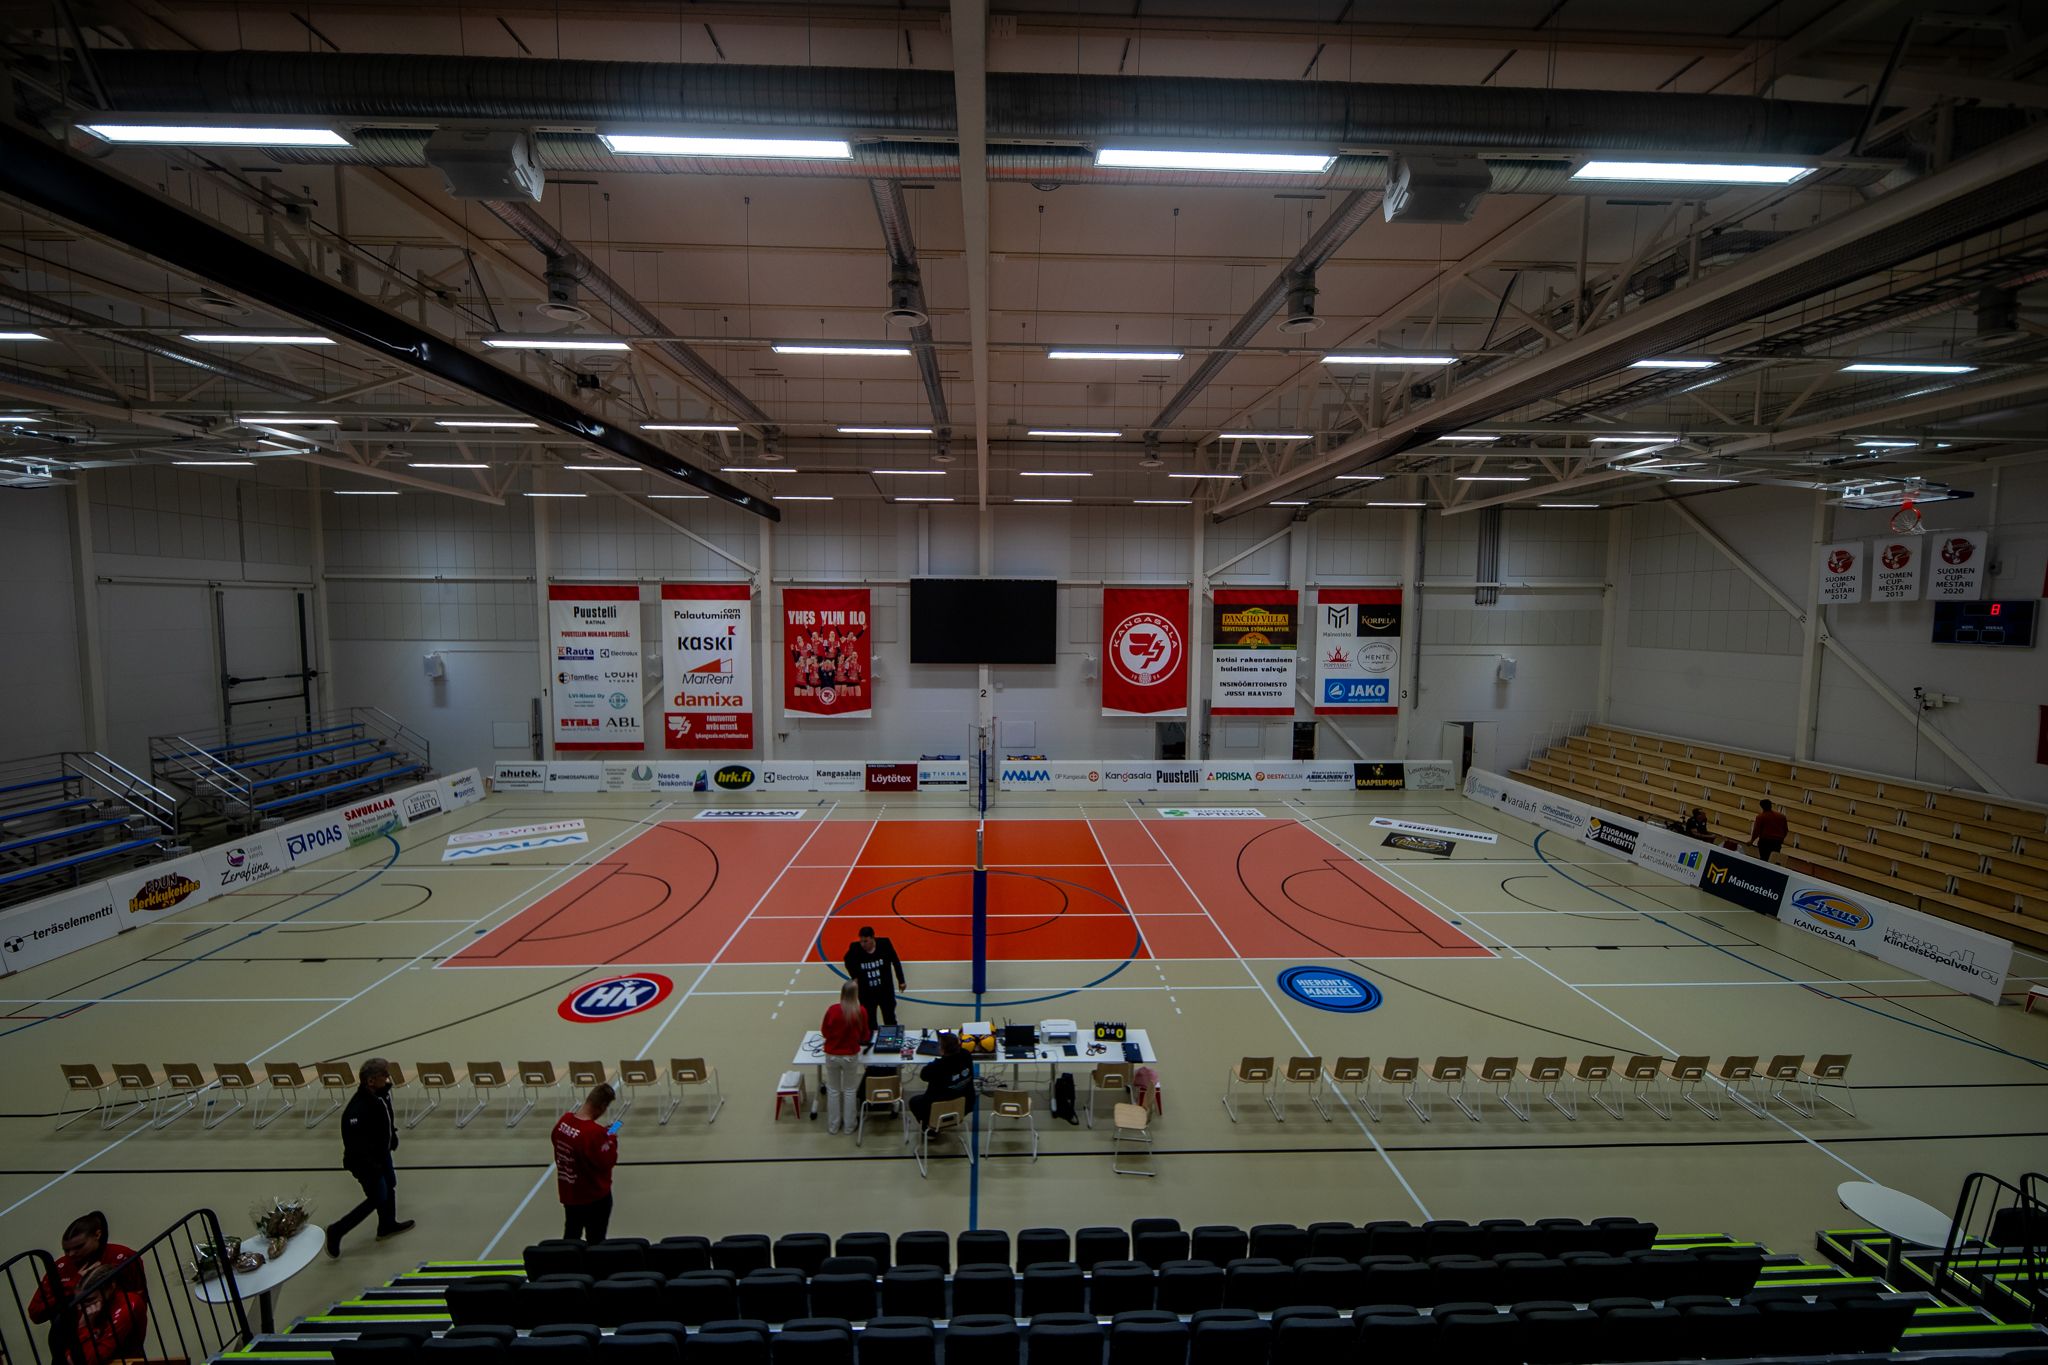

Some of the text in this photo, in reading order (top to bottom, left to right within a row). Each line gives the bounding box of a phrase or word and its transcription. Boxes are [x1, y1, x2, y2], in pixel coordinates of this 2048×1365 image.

[1879, 572, 1913, 580] SUOMEN
[1937, 567, 1975, 575] SUOMEN
[1878, 584, 1912, 592] MESTARI
[573, 605, 617, 618] Puustelli
[674, 610, 741, 620] Palautuminen
[1991, 603, 2001, 616] 8
[849, 611, 866, 625] ILO
[1223, 615, 1287, 623] PANCHO VILLA
[1113, 616, 1179, 649] KANGASALA
[566, 647, 594, 656] Rauta
[605, 671, 639, 679] LOUHI
[682, 673, 734, 685] MarRent
[981, 689, 987, 697] 2
[1347, 685, 1386, 697] JAKO
[1401, 690, 1408, 699] 3
[674, 692, 744, 706] damixa
[606, 717, 641, 728] ABL
[718, 769, 752, 784] hrk.fi
[816, 769, 862, 779] Kangasalan
[872, 773, 912, 785] Löytötex
[1002, 770, 1050, 781] MALM
[1105, 771, 1152, 783] Kangasala
[1156, 769, 1199, 783] Puustelli
[1215, 771, 1253, 781] PRISMA
[344, 798, 396, 822] SAVUKALAA
[407, 797, 438, 815] LEHTO
[1507, 796, 1537, 813] varala.fi
[306, 825, 343, 850] POAS
[1600, 832, 1635, 851] ELEMENTTI
[1727, 874, 1780, 901] Mainosteko
[1792, 894, 1862, 927] Fixus
[33, 904, 114, 941] teräselementti
[1793, 918, 1857, 948] KANGASALA
[1883, 934, 1999, 986] Kiinteistöpalvelu Oy
[580, 985, 653, 1008] HK
[558, 1121, 581, 1139] STAFF
